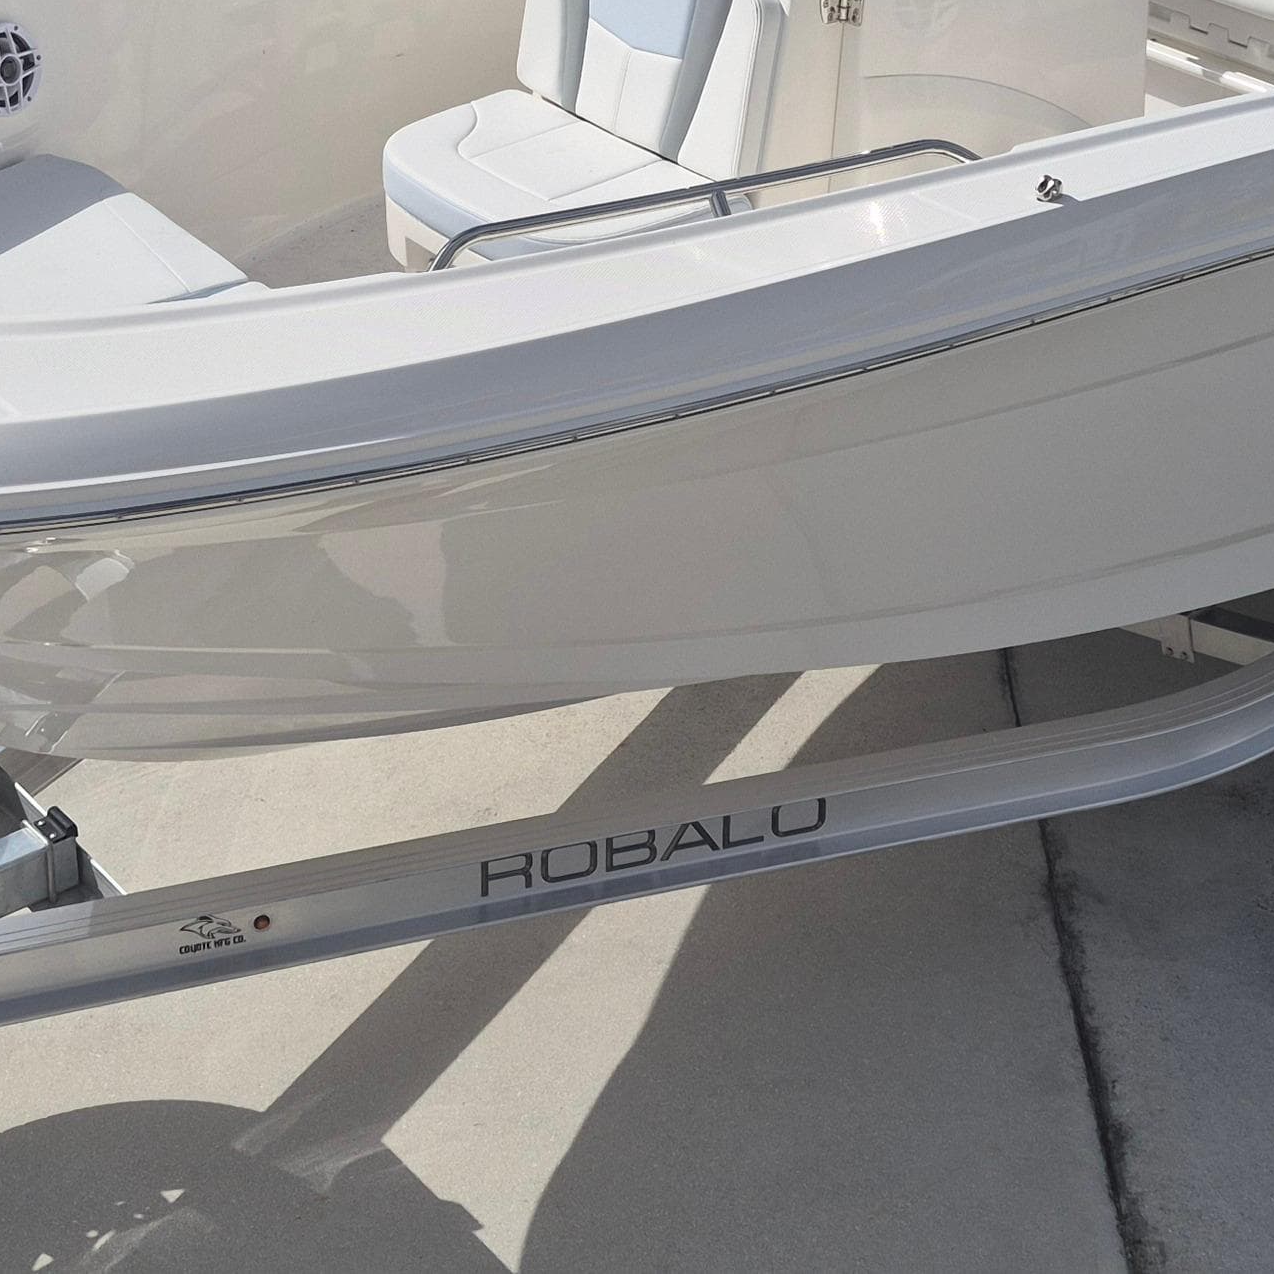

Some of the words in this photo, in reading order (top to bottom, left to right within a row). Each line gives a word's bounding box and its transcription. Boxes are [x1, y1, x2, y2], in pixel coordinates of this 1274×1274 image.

[480, 796, 827, 898] ROBALO
[179, 940, 213, 955] COYOTE
[232, 934, 247, 944] CO.
